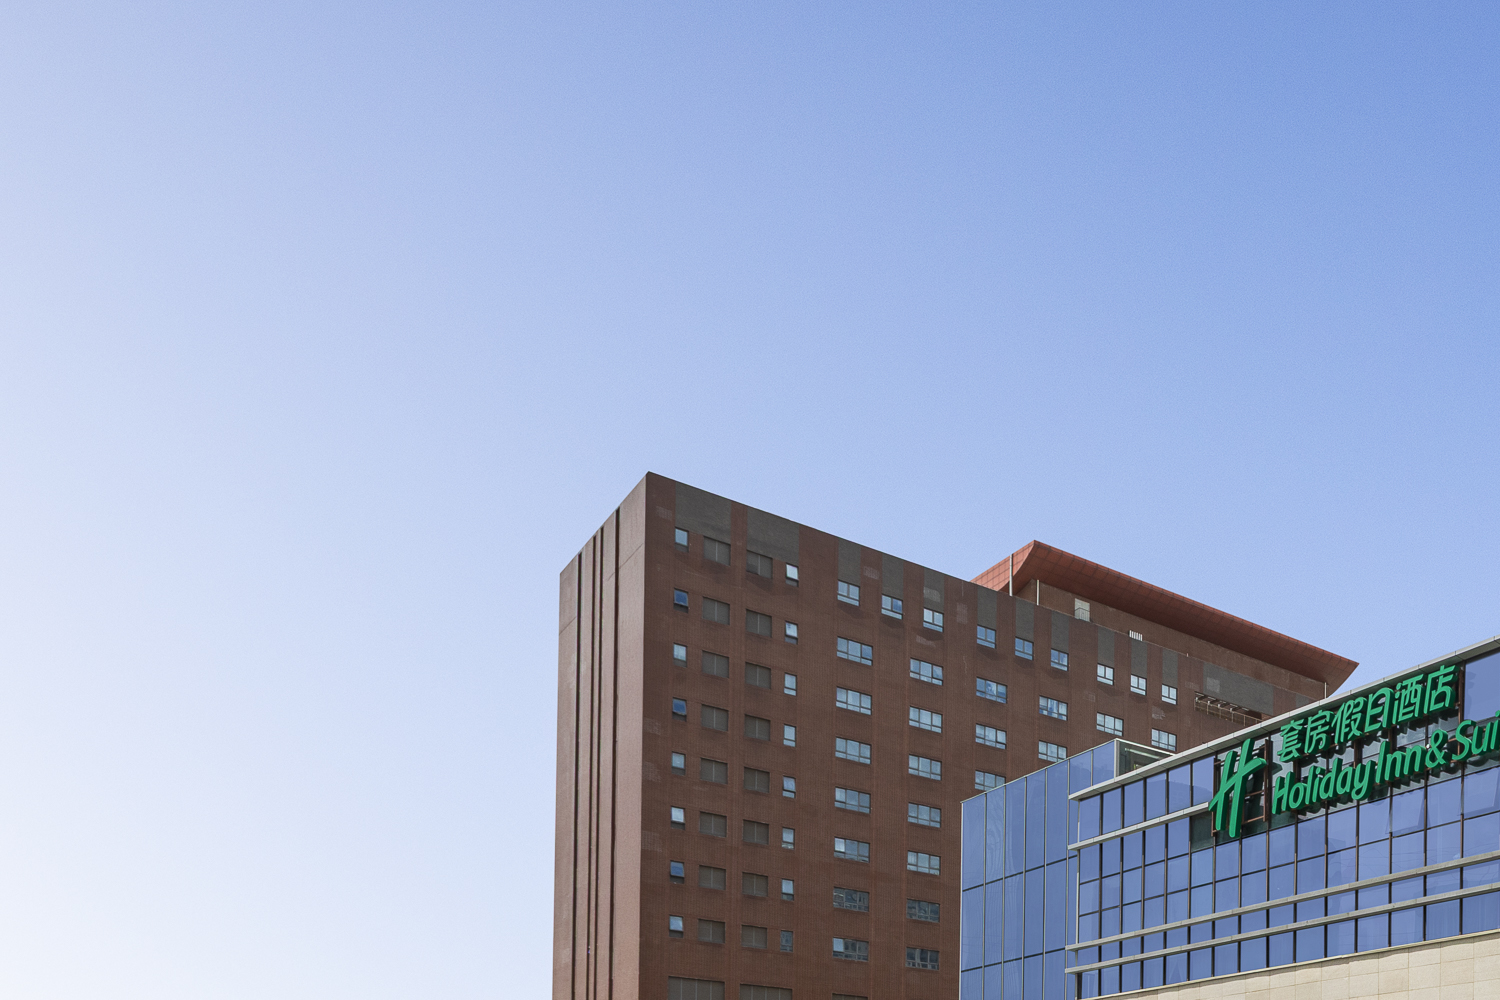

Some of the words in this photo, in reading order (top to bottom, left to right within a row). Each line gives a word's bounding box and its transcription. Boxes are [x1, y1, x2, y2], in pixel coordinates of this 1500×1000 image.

[1277, 665, 1459, 762] 套房假日酒店
[1272, 757, 1376, 815] Holiday
